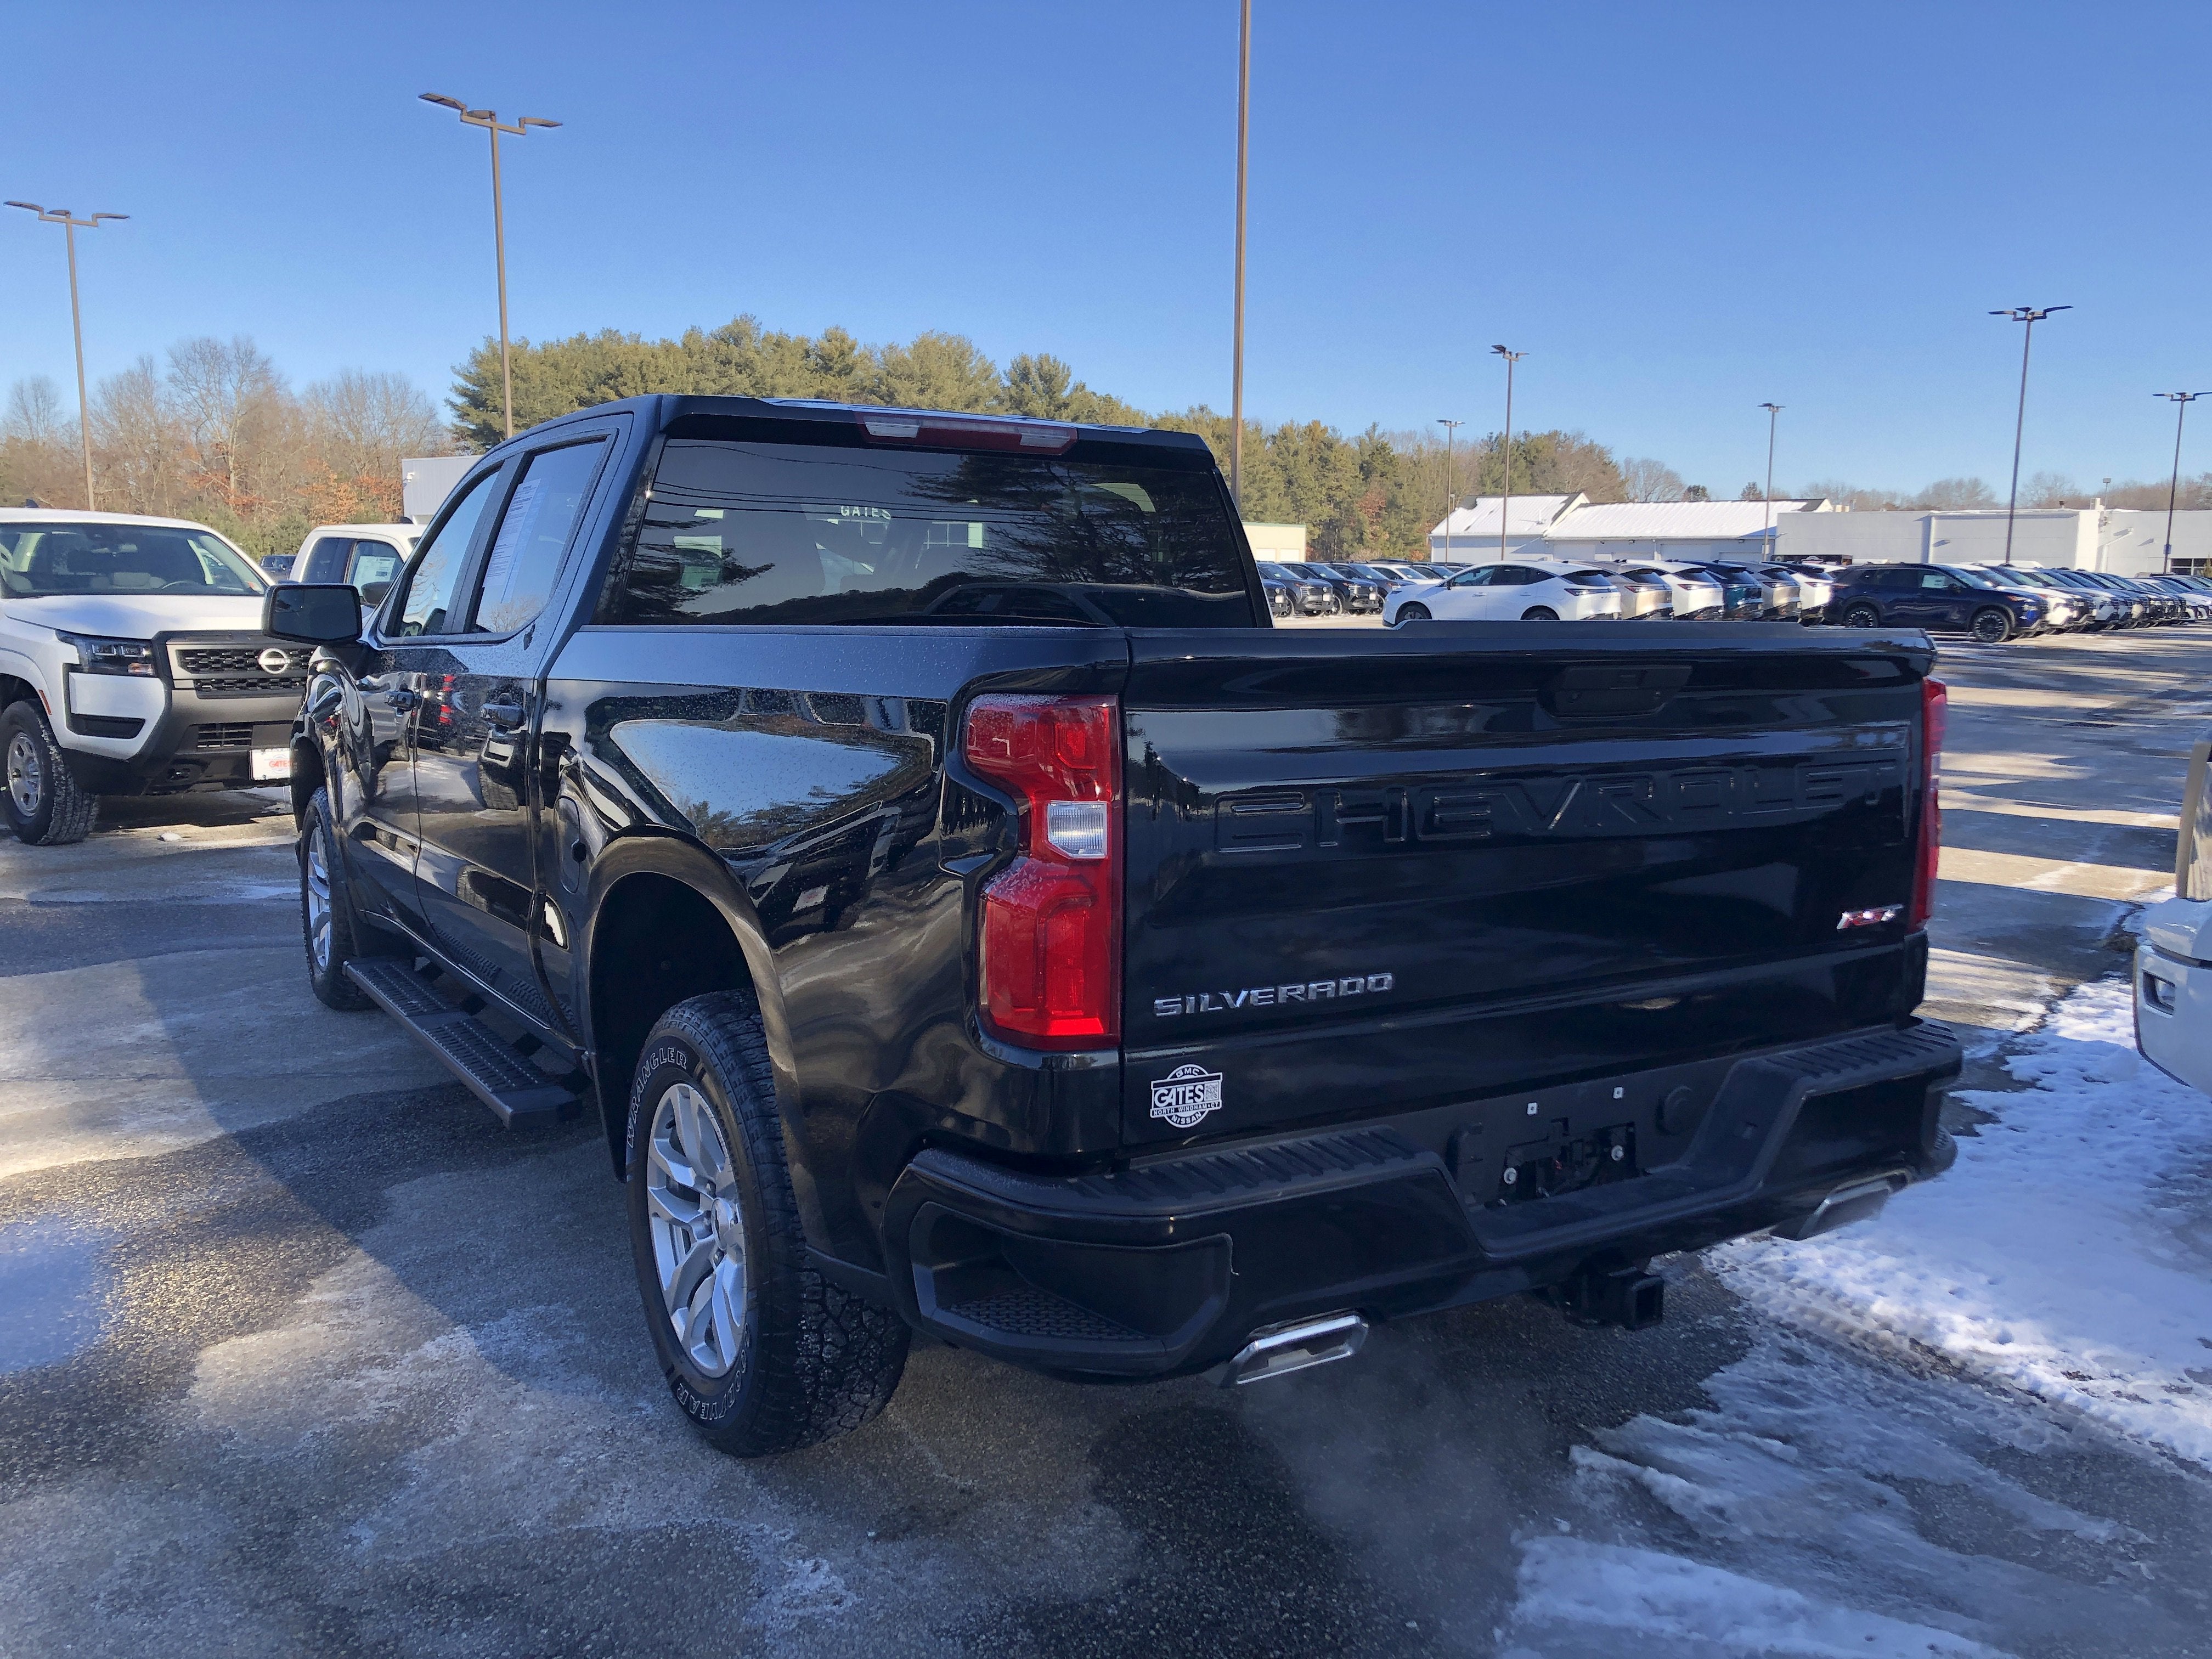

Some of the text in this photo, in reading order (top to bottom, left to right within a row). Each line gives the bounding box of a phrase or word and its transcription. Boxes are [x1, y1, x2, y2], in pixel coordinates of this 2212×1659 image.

[1214, 758, 1901, 854] CHEVROLET
[1154, 972, 1393, 1017] SILVERADO
[627, 1047, 687, 1148] WRANGLER
[1154, 1085, 1204, 1107] GATES
[1171, 1111, 1201, 1125] NISSAN
